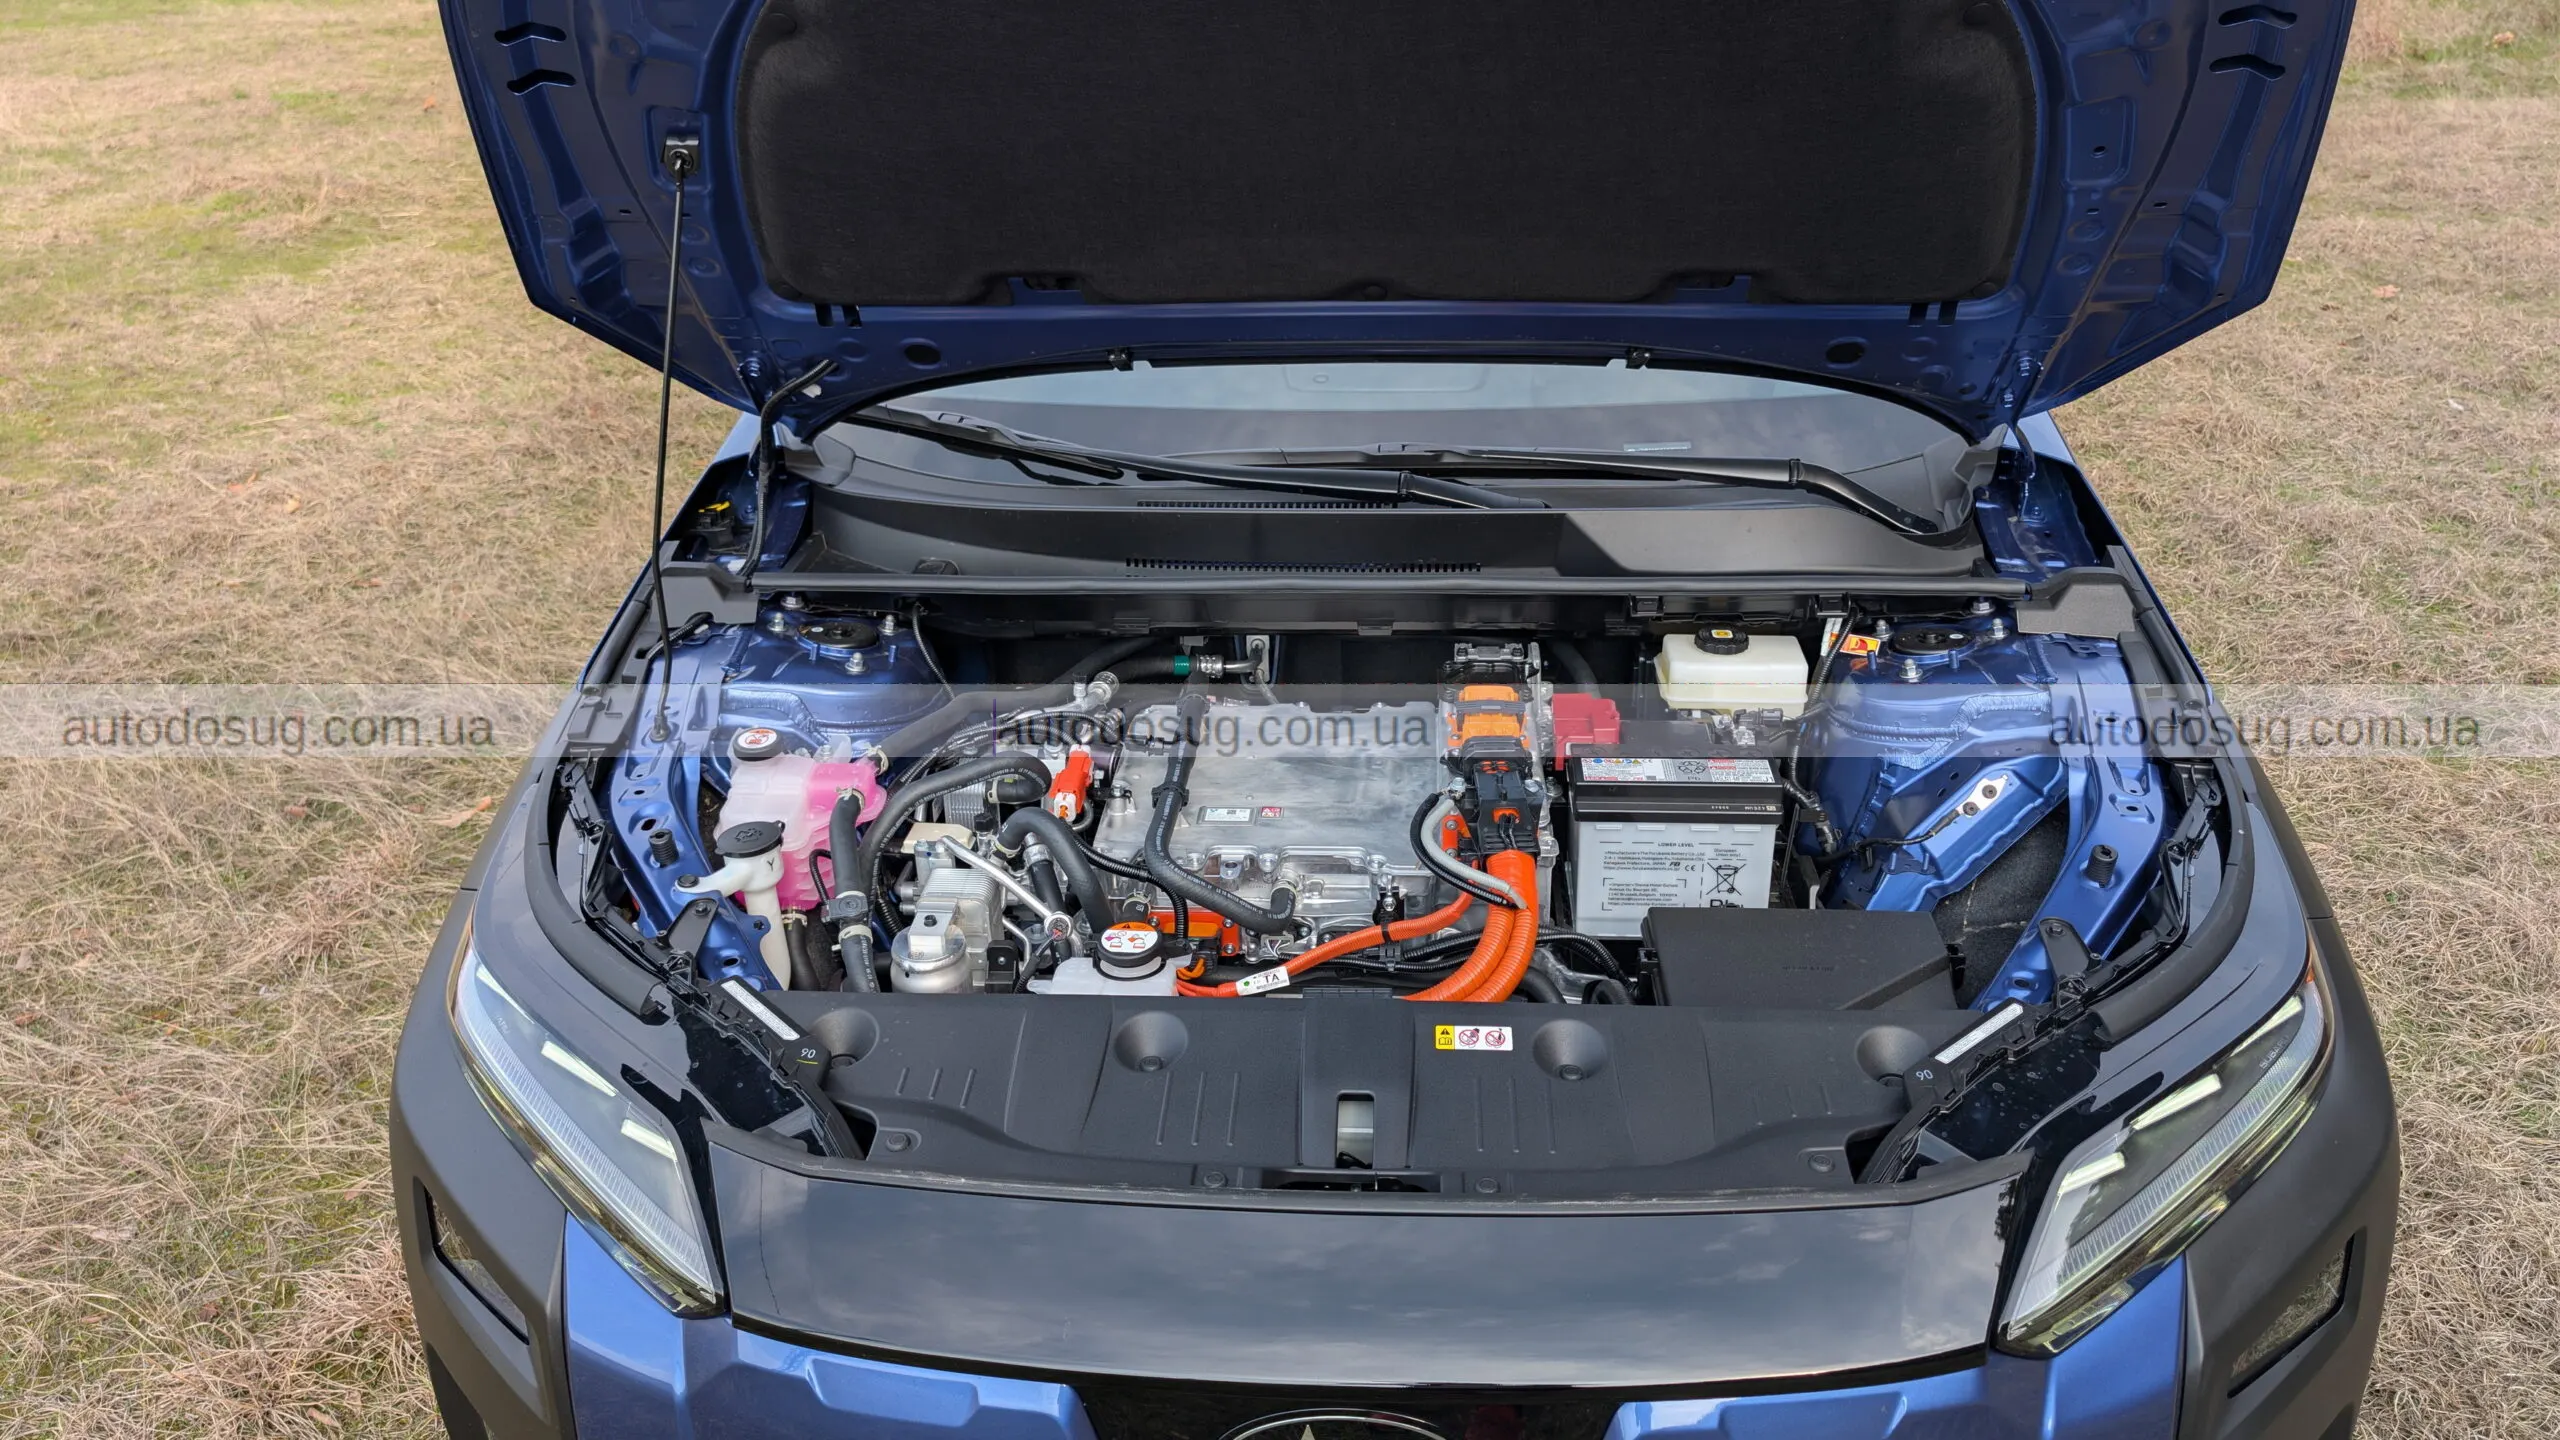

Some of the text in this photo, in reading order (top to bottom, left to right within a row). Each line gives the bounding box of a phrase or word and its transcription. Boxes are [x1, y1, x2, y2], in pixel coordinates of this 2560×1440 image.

[1263, 973, 1280, 984] TA
[800, 1047, 816, 1059] 90
[1915, 1069, 1934, 1081] 90
